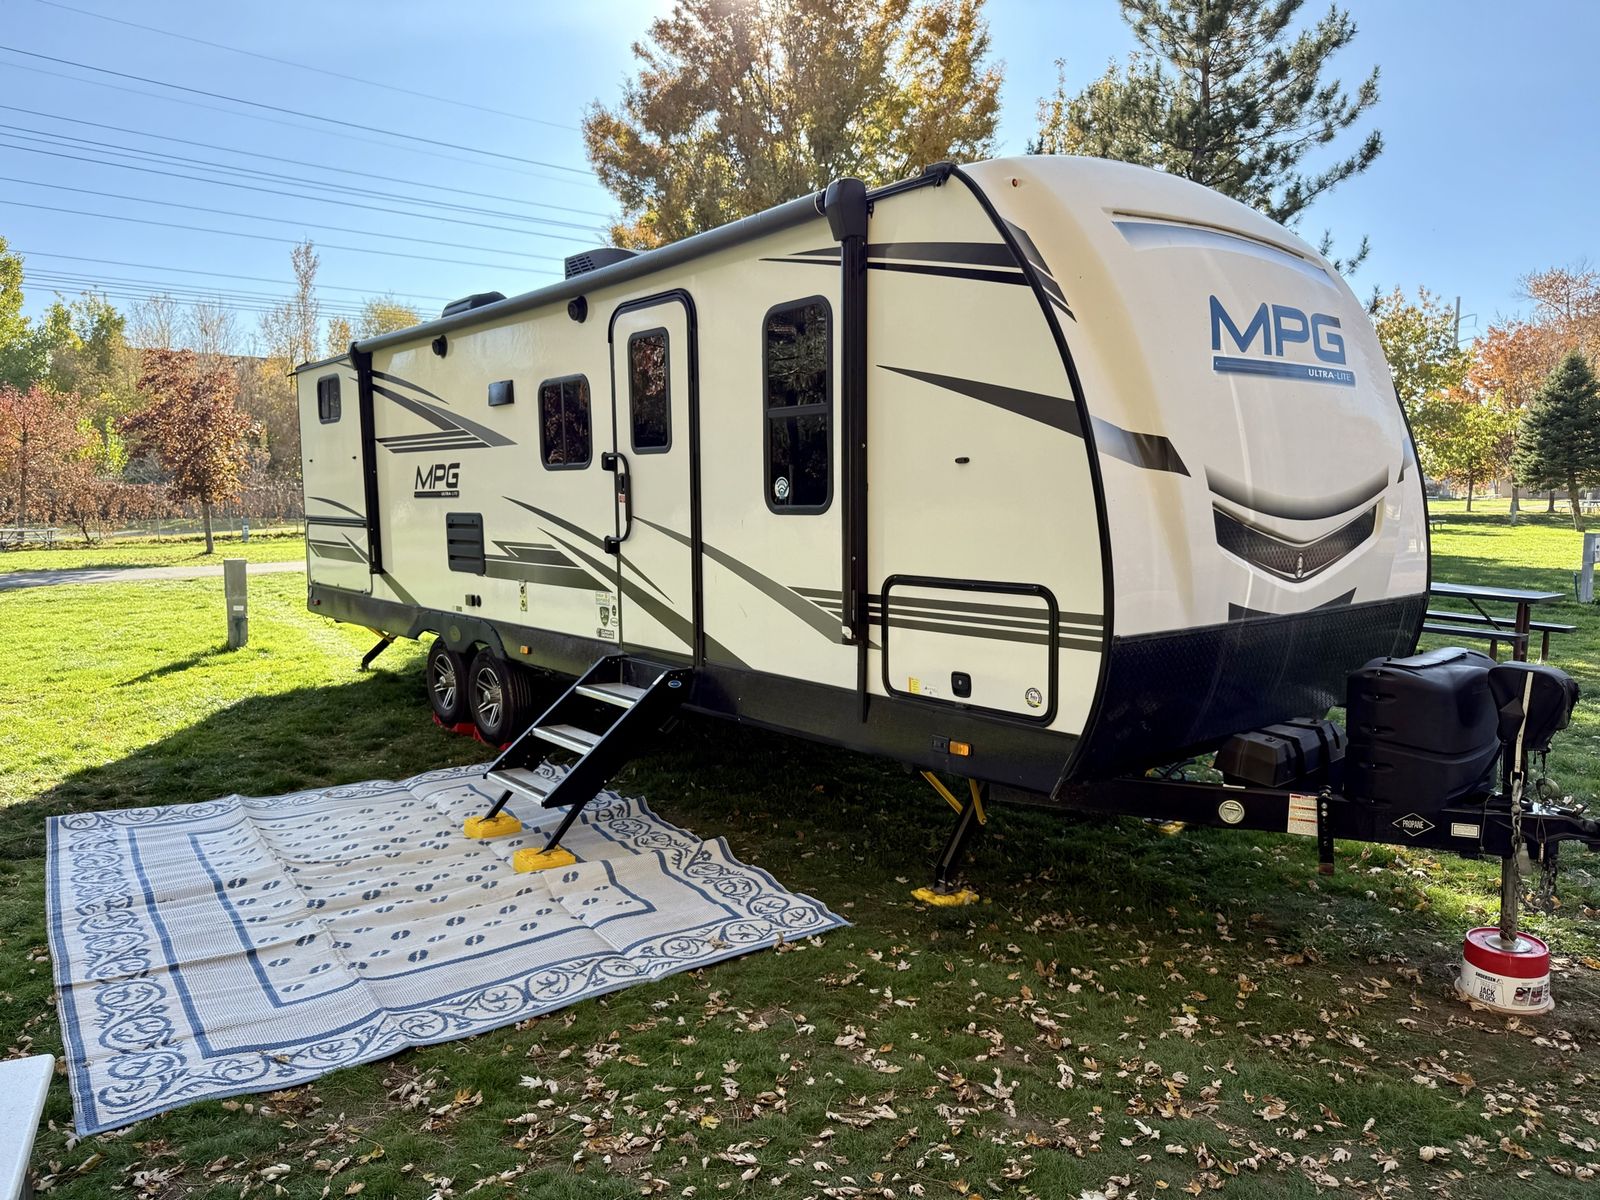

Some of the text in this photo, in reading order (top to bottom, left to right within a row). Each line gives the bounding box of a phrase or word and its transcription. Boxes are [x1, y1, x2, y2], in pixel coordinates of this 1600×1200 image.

[1209, 294, 1346, 365] MPG
[1308, 368, 1351, 381] ULTRA-LITE
[415, 463, 460, 490] MPG
[1402, 819, 1424, 829] PROPANE
[1480, 986, 1496, 997] JACK
